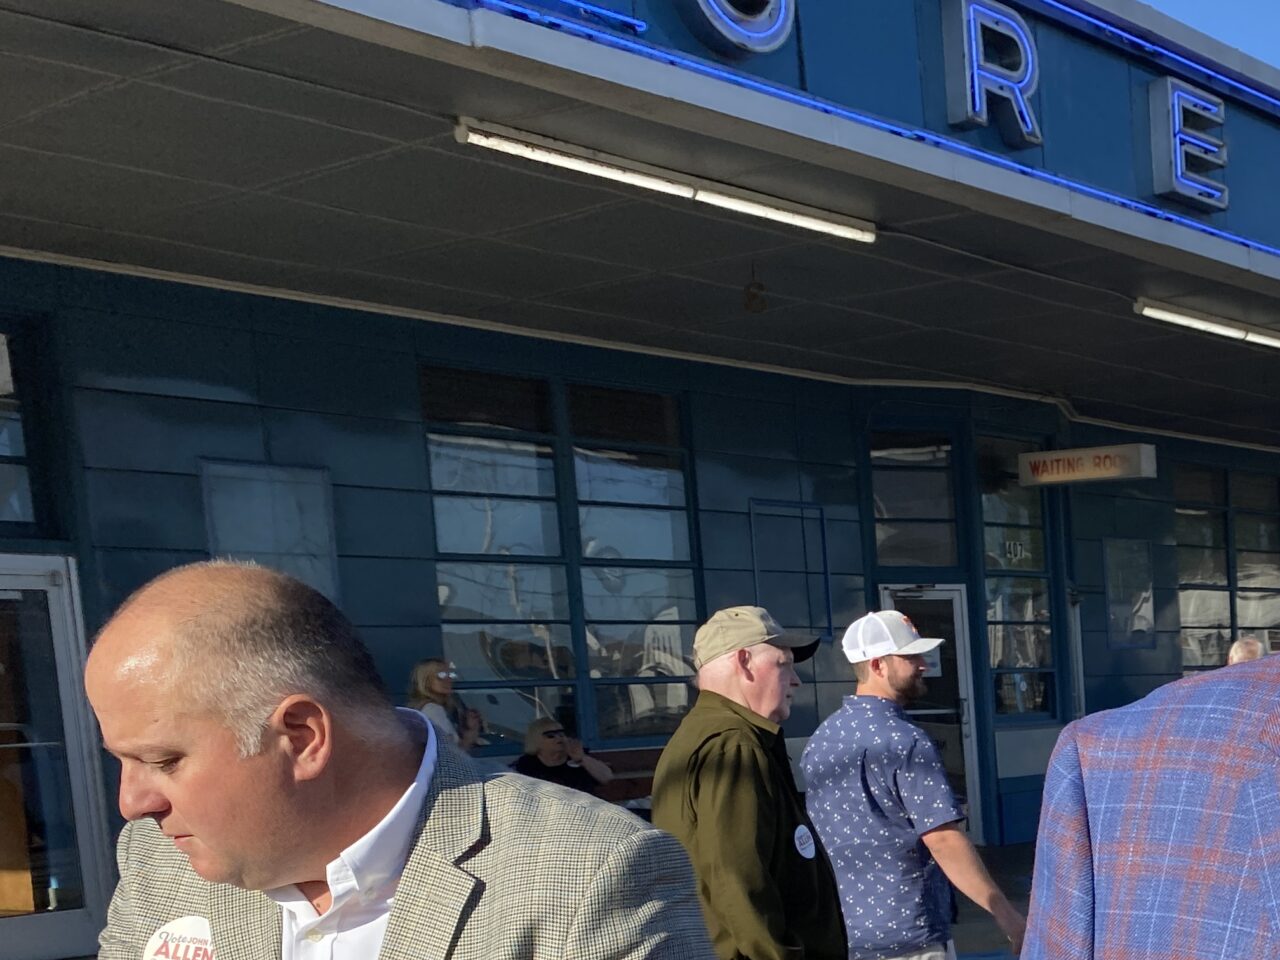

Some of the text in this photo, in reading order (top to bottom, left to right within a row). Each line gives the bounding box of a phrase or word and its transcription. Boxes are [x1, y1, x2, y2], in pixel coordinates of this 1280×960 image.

[1029, 453, 1131, 478] WAITING ROO
[1007, 541, 1024, 558] 407
[159, 931, 187, 944] Vote
[187, 936, 209, 946] JOHN
